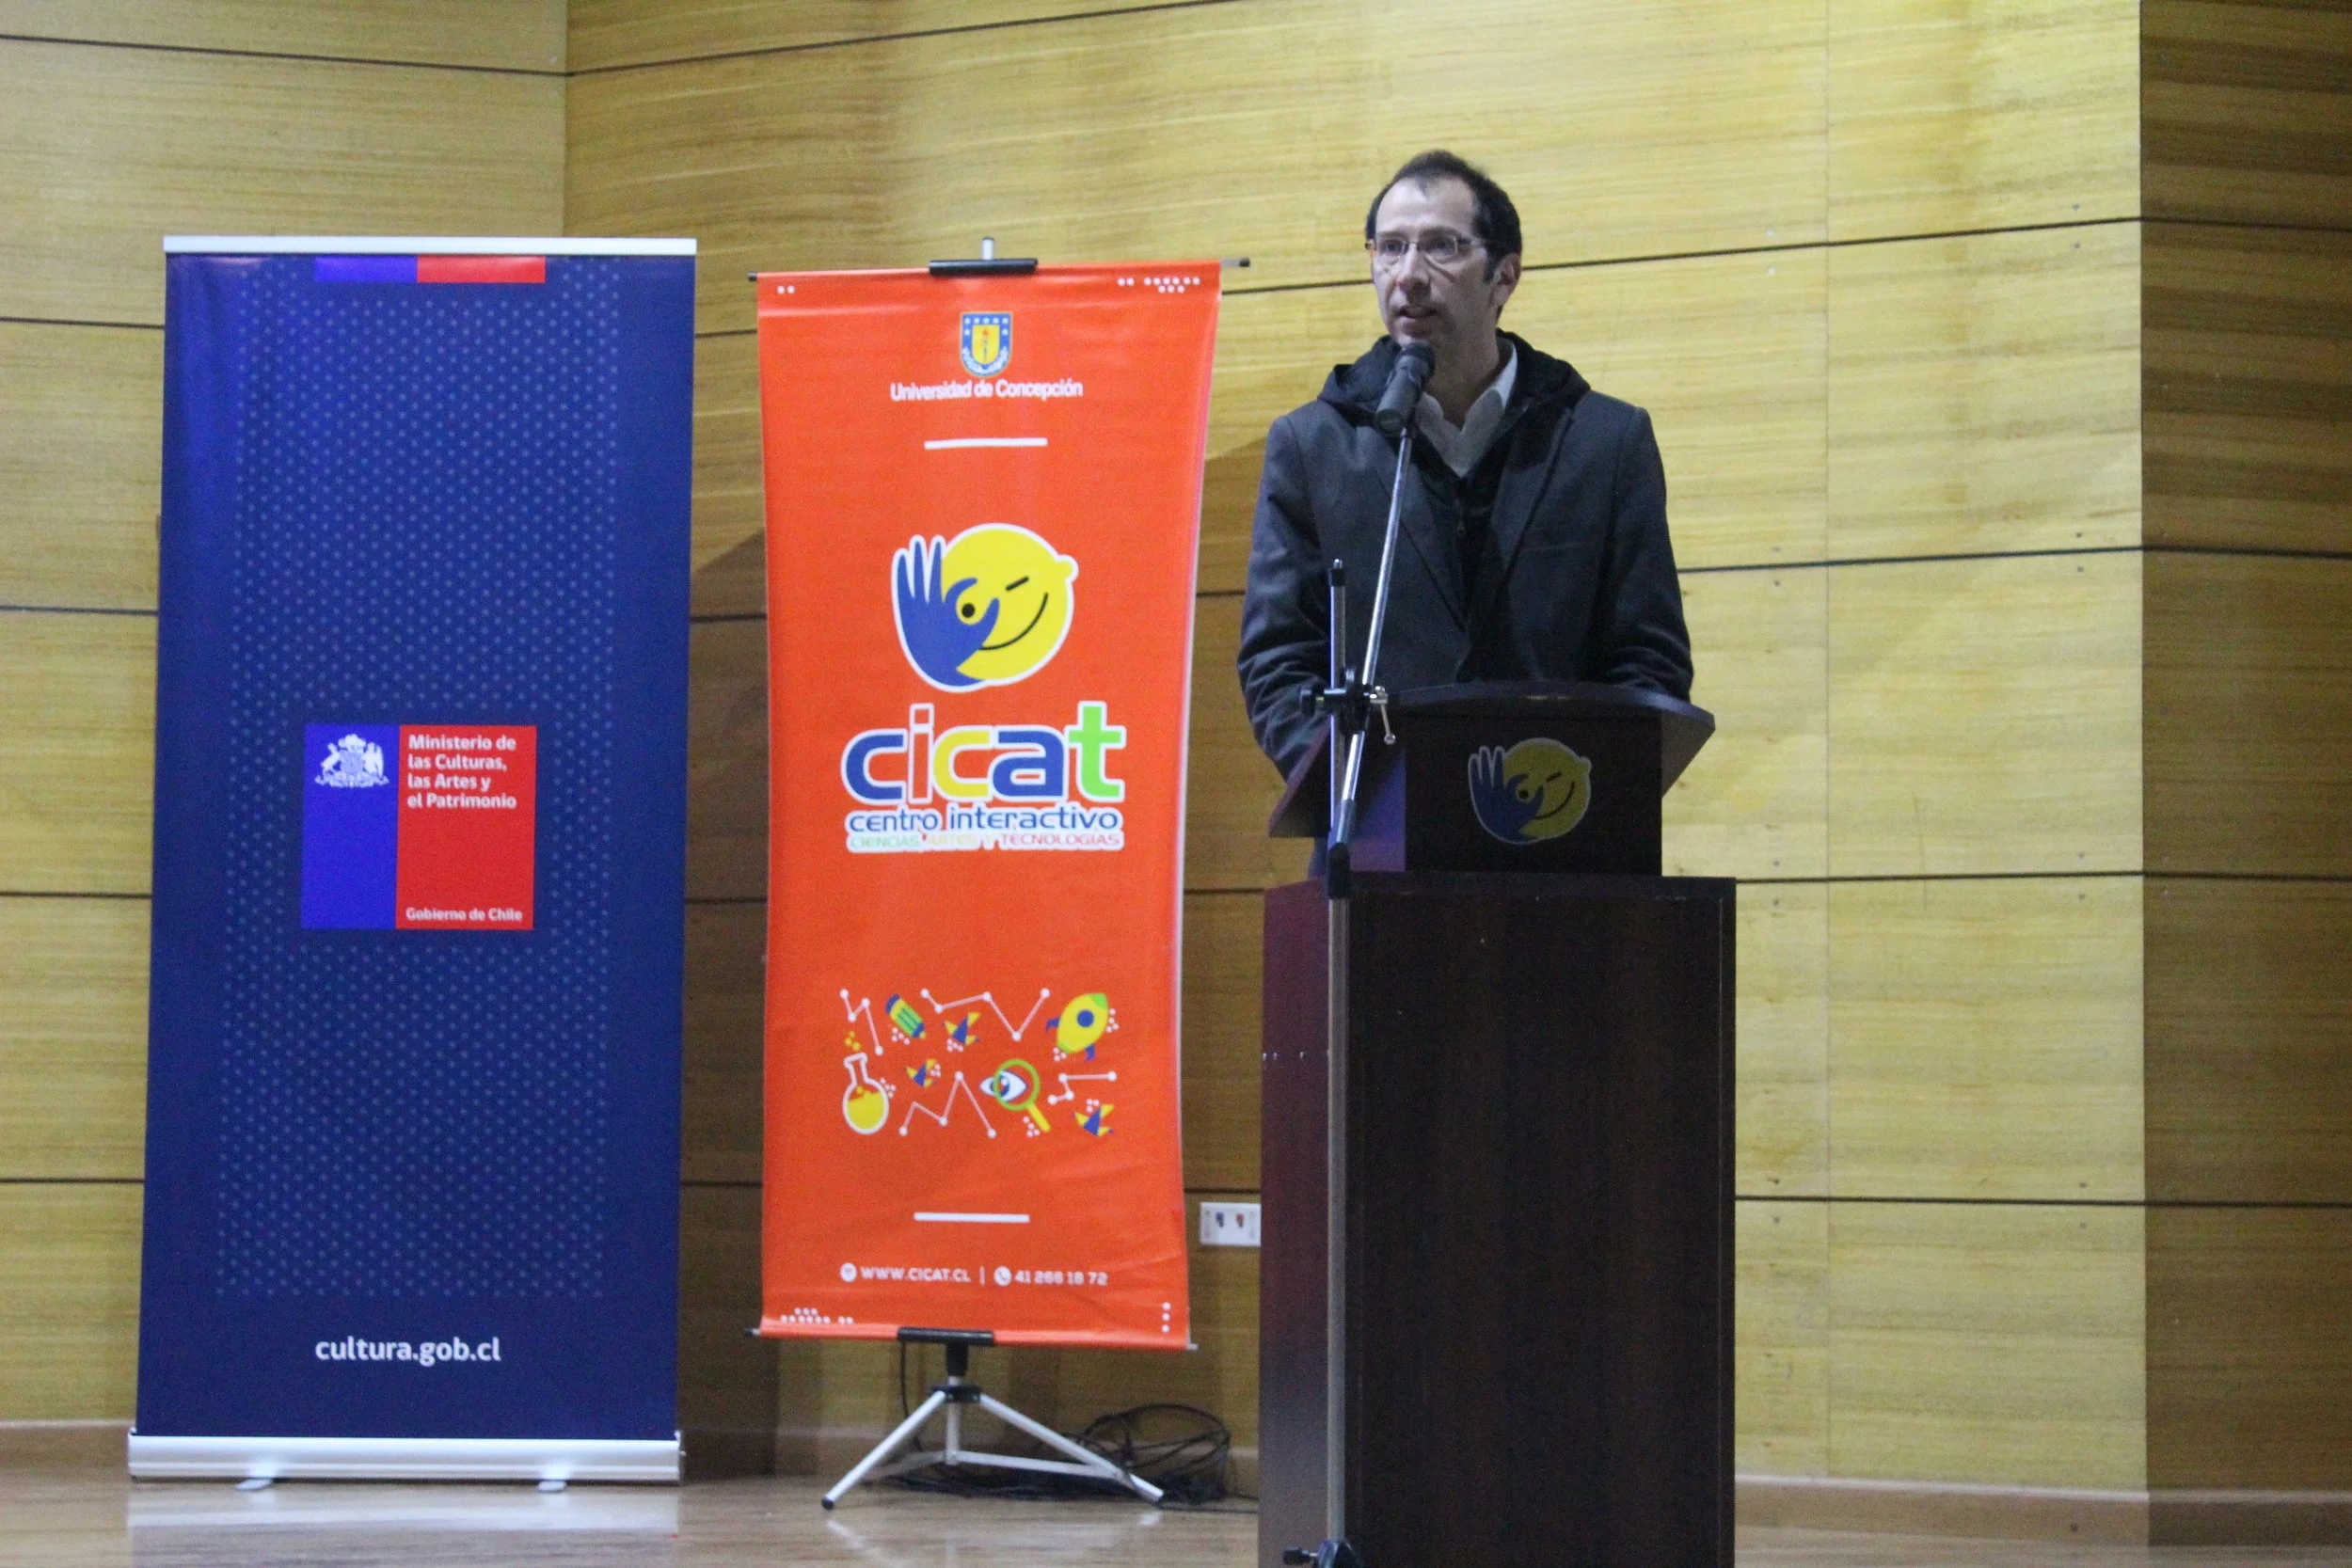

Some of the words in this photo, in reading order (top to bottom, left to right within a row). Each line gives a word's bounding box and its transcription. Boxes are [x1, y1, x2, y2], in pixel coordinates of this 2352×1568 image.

[890, 379, 972, 401] Universidad
[974, 379, 993, 397] de
[995, 377, 1084, 401] Concepción
[408, 734, 492, 751] Ministerio
[496, 735, 516, 751] de
[407, 753, 431, 769] las
[435, 753, 507, 772] Culturas,
[841, 700, 1127, 806] cicat
[407, 772, 431, 789] las
[435, 773, 478, 789] Artes
[480, 776, 491, 792] y
[406, 792, 422, 808] el
[426, 792, 517, 809] Patrimonio
[849, 806, 940, 832] centro
[948, 804, 1120, 831] interactivo
[405, 907, 467, 922] Gobierno
[469, 907, 485, 922] de
[488, 907, 522, 922] Chile
[861, 1265, 972, 1283] WWW.CICAT.CL
[315, 1335, 501, 1367] cultura.gob.cl
